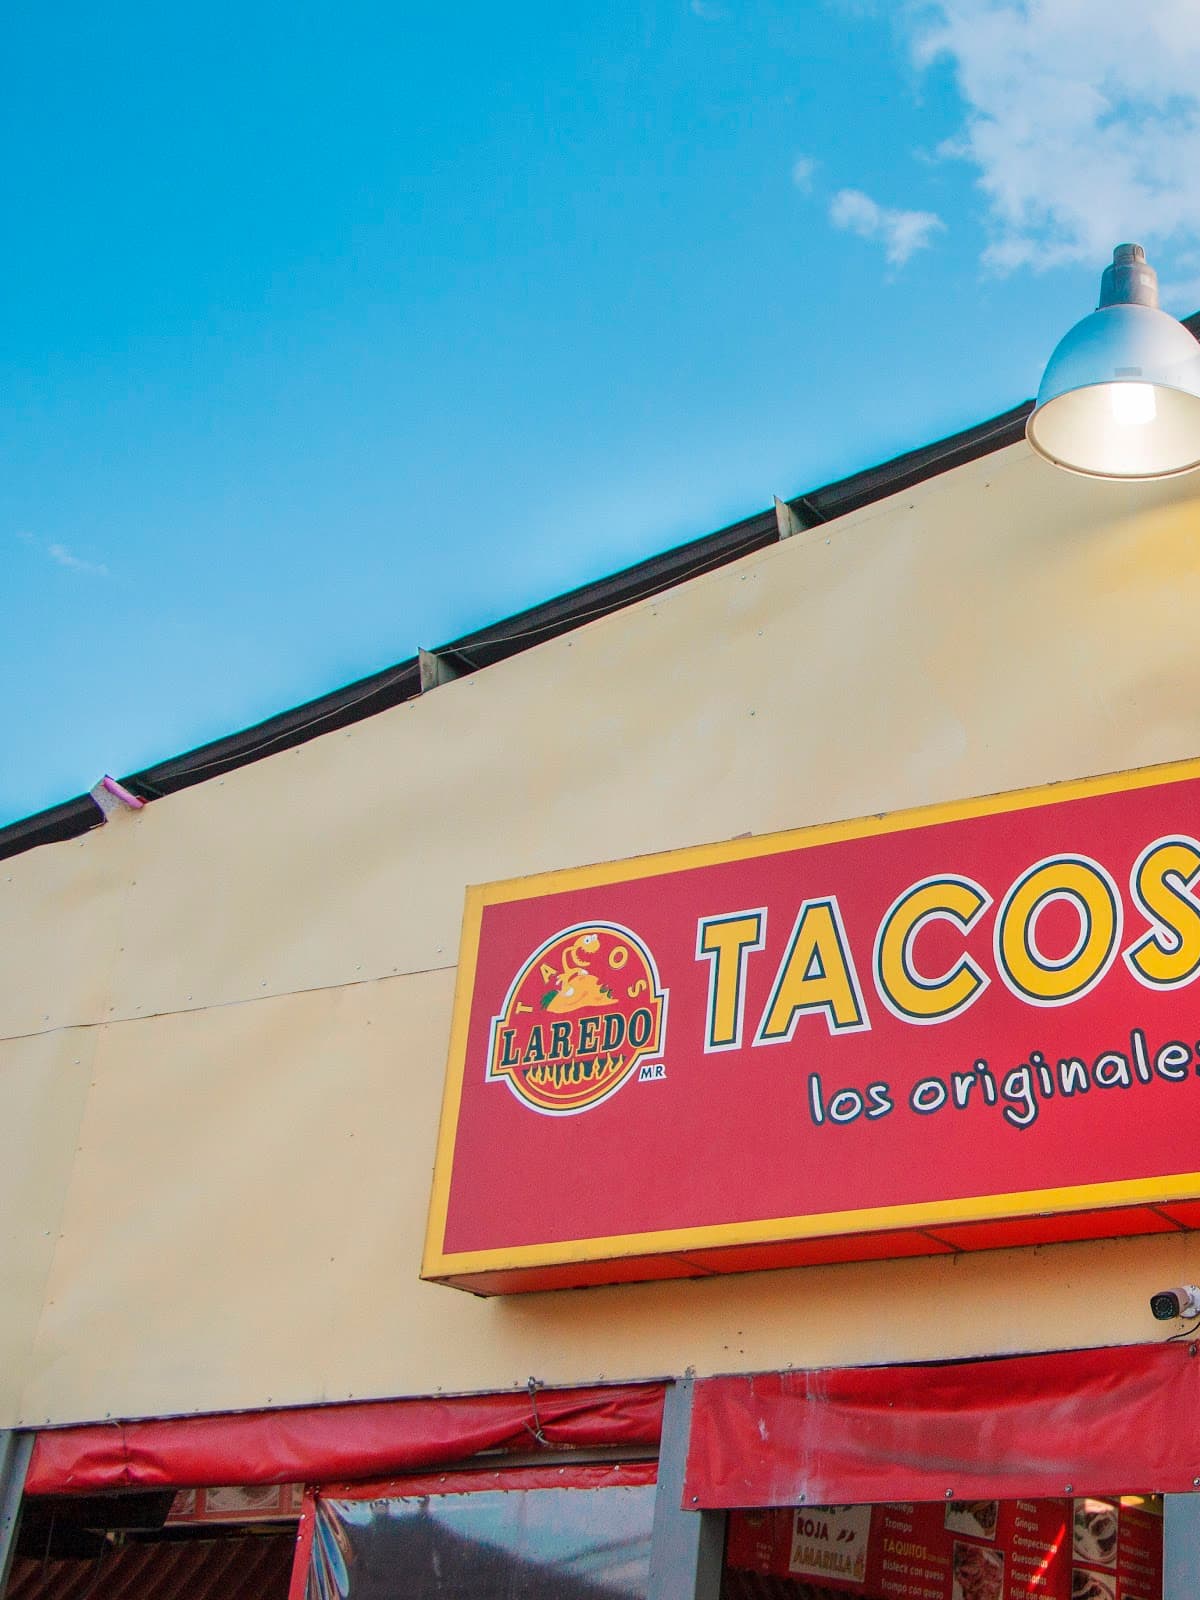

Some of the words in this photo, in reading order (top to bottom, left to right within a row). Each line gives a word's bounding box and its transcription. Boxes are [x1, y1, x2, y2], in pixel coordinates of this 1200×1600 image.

[499, 1007, 653, 1068] LAREDO
[641, 1064, 665, 1080] MR
[808, 1073, 894, 1126] los
[797, 1517, 829, 1541] ROJA
[793, 1545, 852, 1574] AMARILLA
[882, 1538, 928, 1561] TAQUITOS
